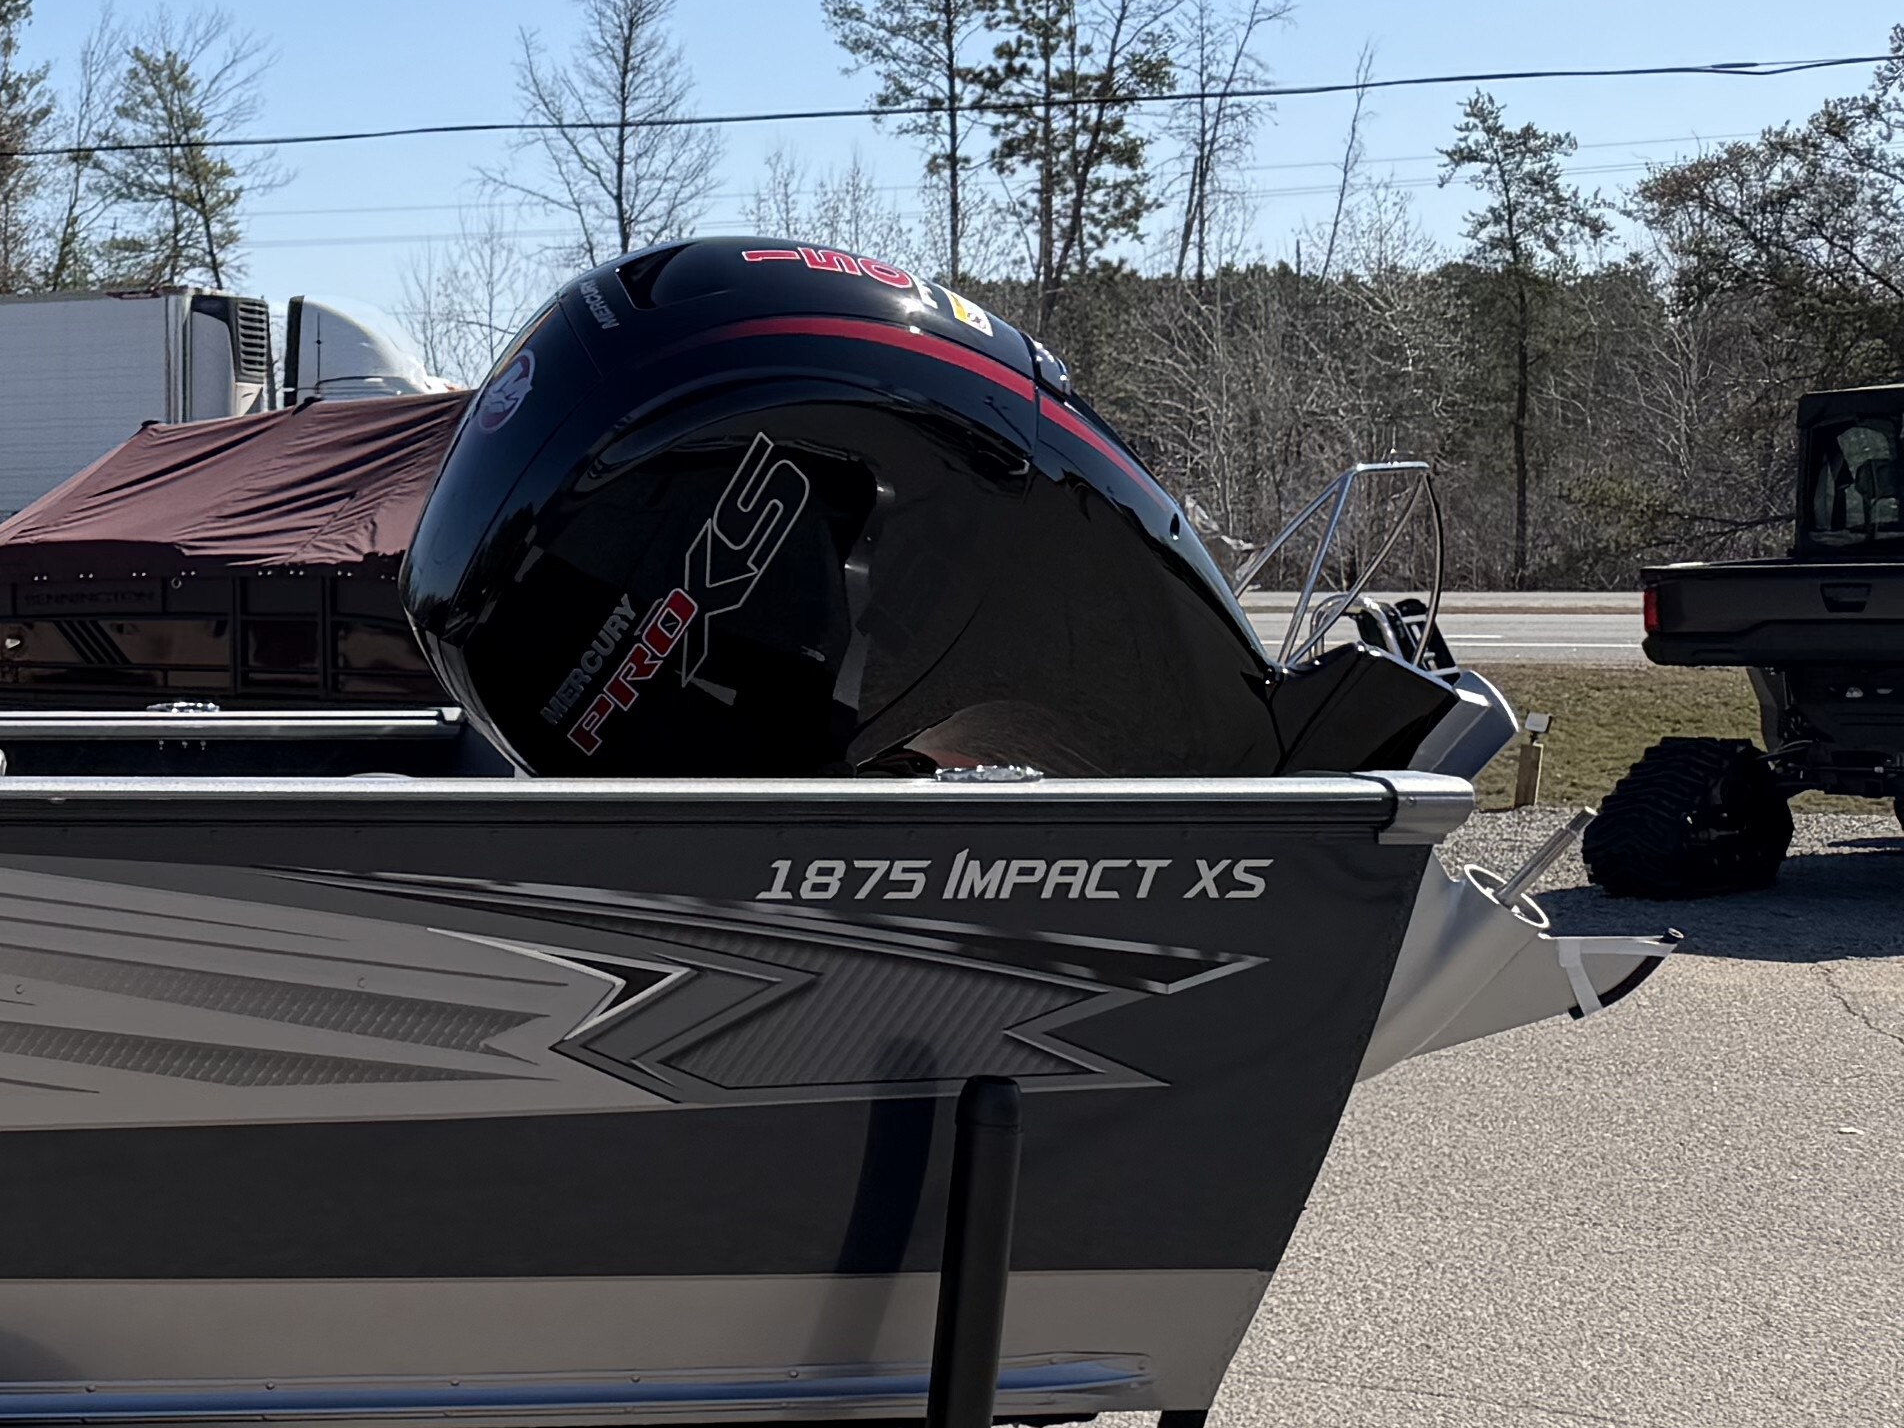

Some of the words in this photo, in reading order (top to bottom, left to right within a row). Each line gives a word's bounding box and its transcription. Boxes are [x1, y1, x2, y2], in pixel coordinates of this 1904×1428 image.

[539, 592, 637, 725] MERCURY
[567, 587, 699, 757] PRO
[681, 431, 810, 689] XS
[754, 859, 933, 900] 1875
[941, 847, 1174, 900] IMPACT
[1181, 859, 1275, 900] XS
